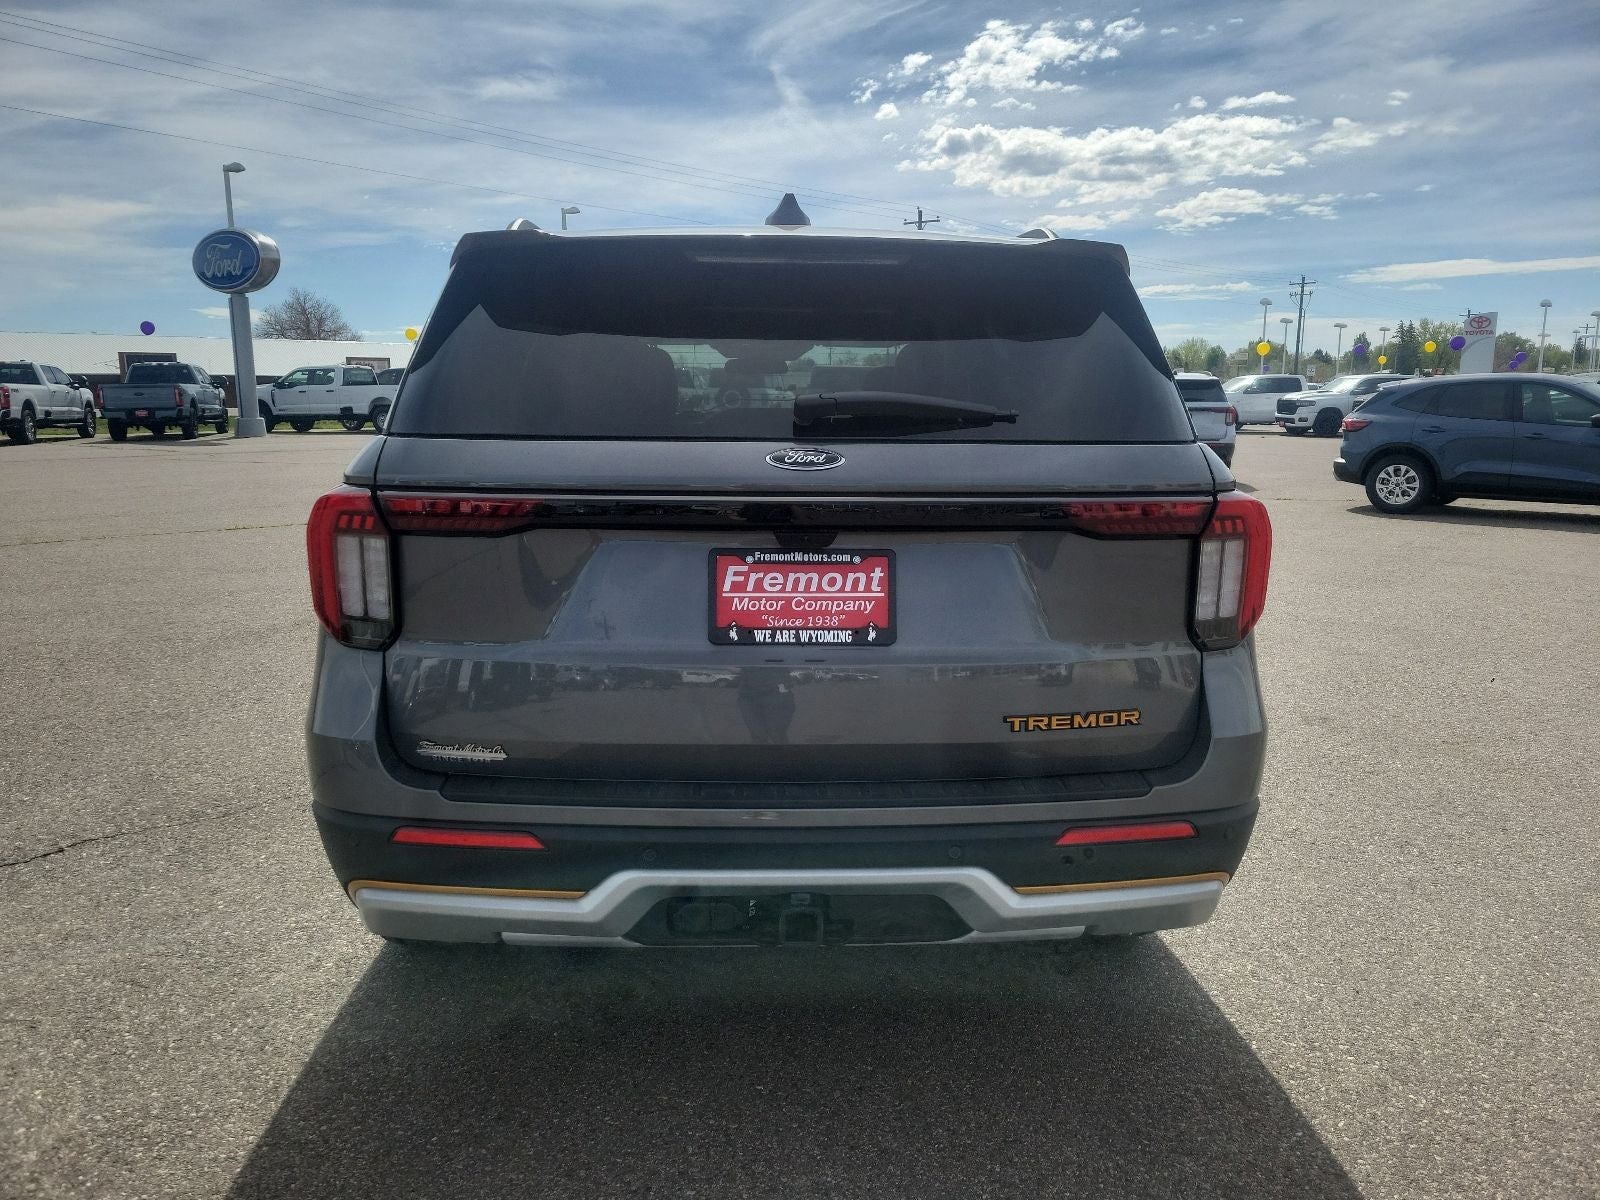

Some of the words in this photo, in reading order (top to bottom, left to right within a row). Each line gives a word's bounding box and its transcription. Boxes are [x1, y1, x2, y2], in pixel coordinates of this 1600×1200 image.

[204, 243, 243, 278] Ford
[785, 451, 827, 463] Ford
[754, 551, 851, 562] FremontMotors.com
[722, 565, 884, 592] Fremont
[731, 597, 785, 611] Motor
[791, 597, 875, 613] Company
[754, 630, 772, 643] WE
[774, 630, 796, 643] ARE
[799, 630, 853, 643] WYOMING
[1003, 708, 1141, 732] TREMOR
